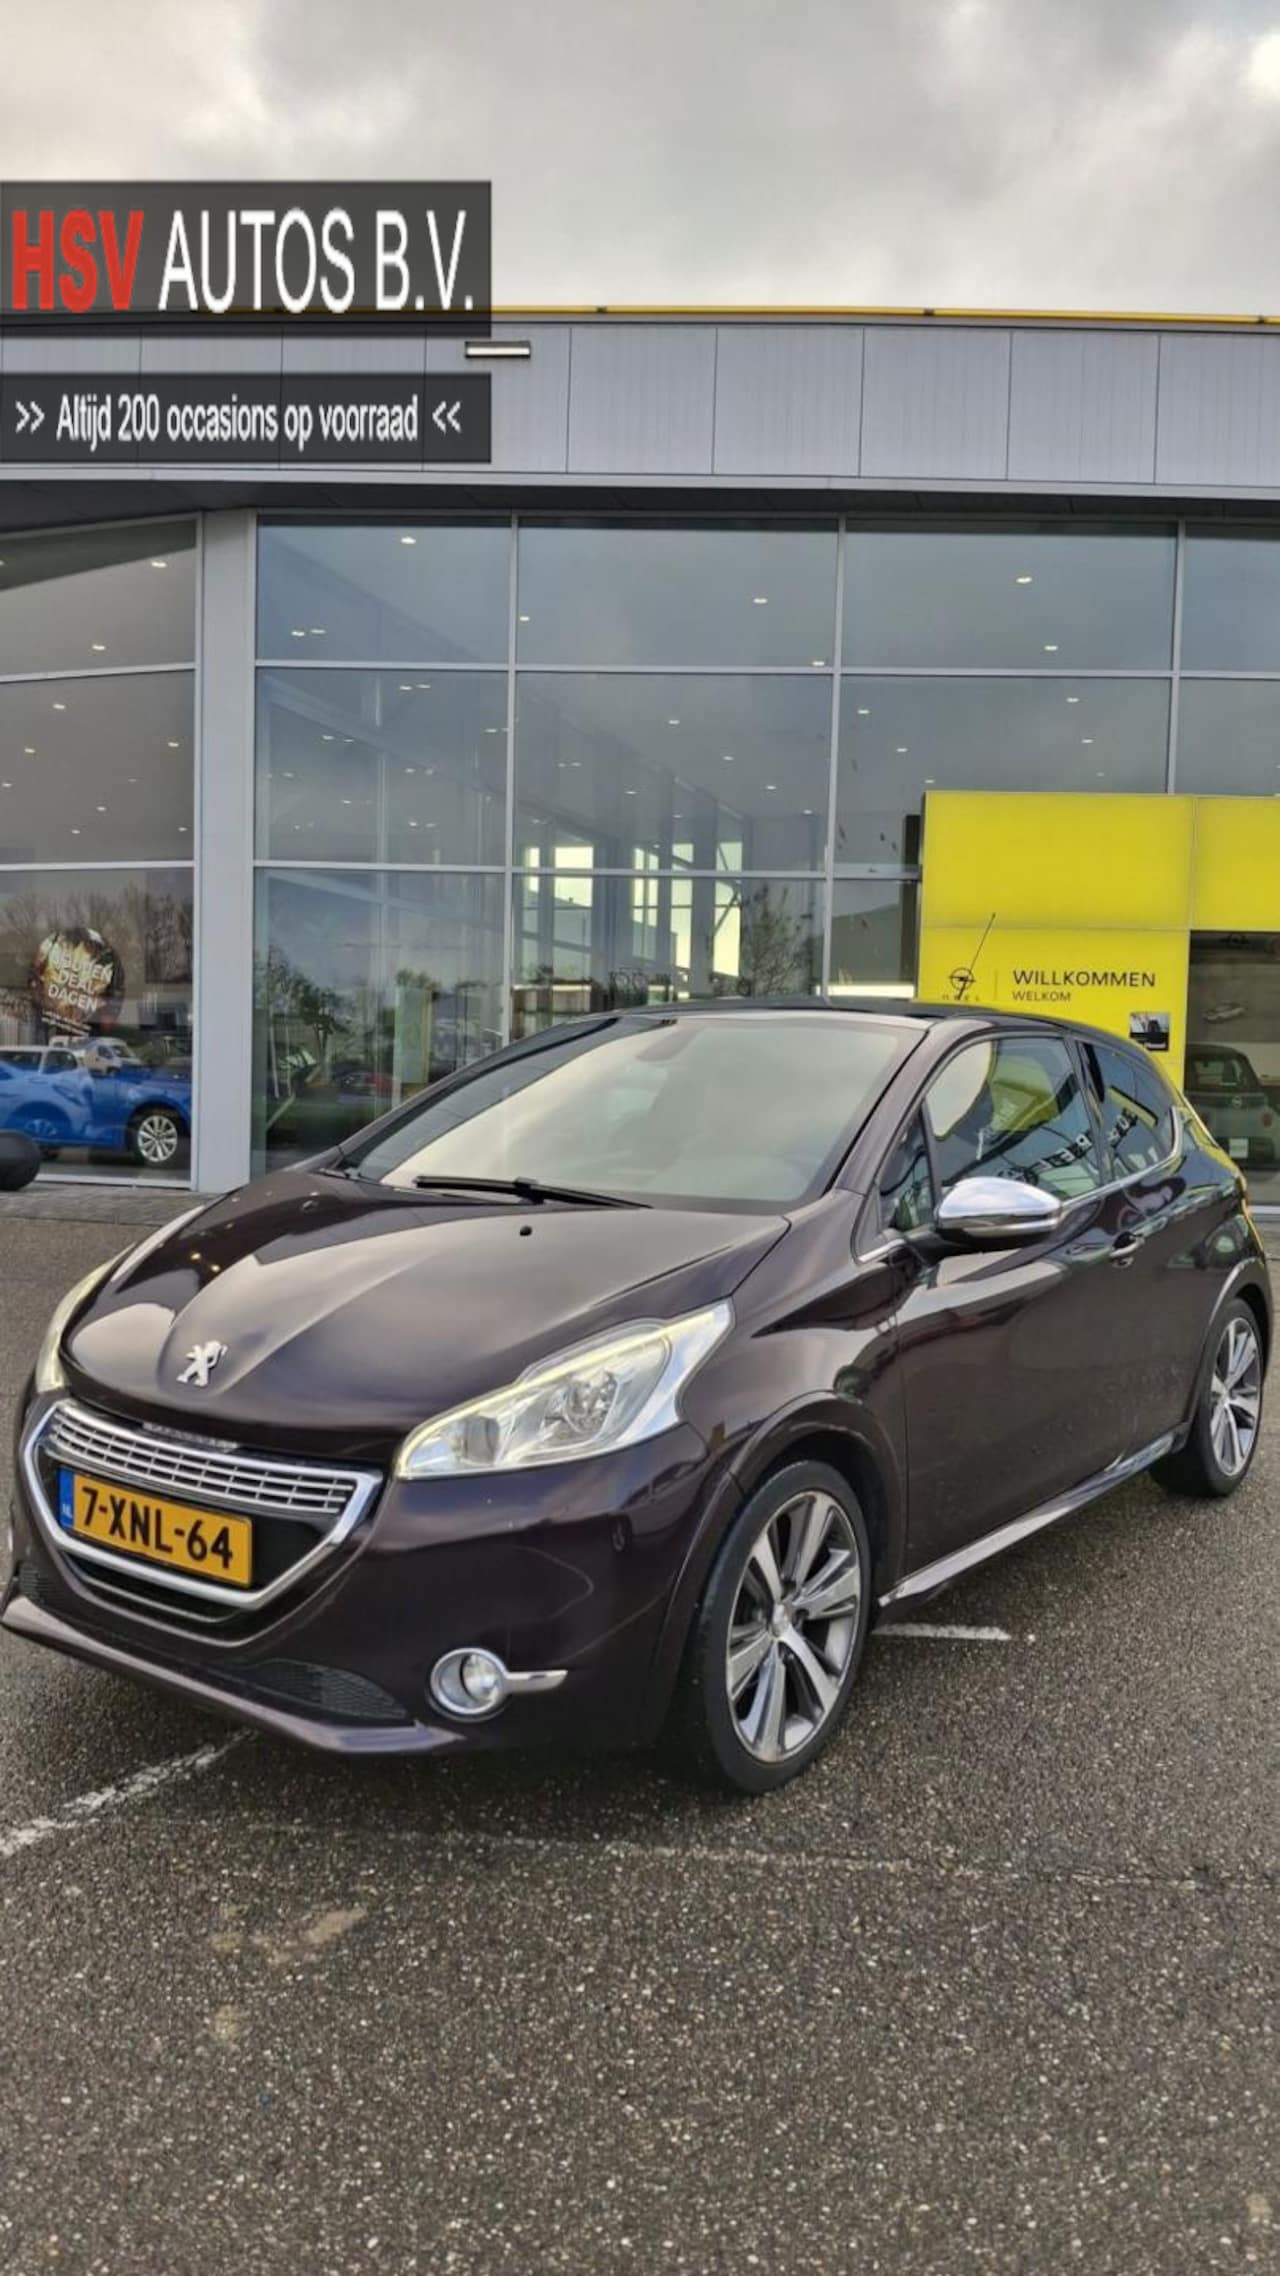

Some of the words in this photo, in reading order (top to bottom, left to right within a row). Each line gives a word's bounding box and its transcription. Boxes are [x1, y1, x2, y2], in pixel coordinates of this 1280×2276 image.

[1013, 970, 1156, 987] WILLKOMMEN
[48, 983, 98, 1012] DAGEN
[1012, 990, 1072, 1002] WELKOM
[82, 1486, 233, 1569] 7-XNL-64
